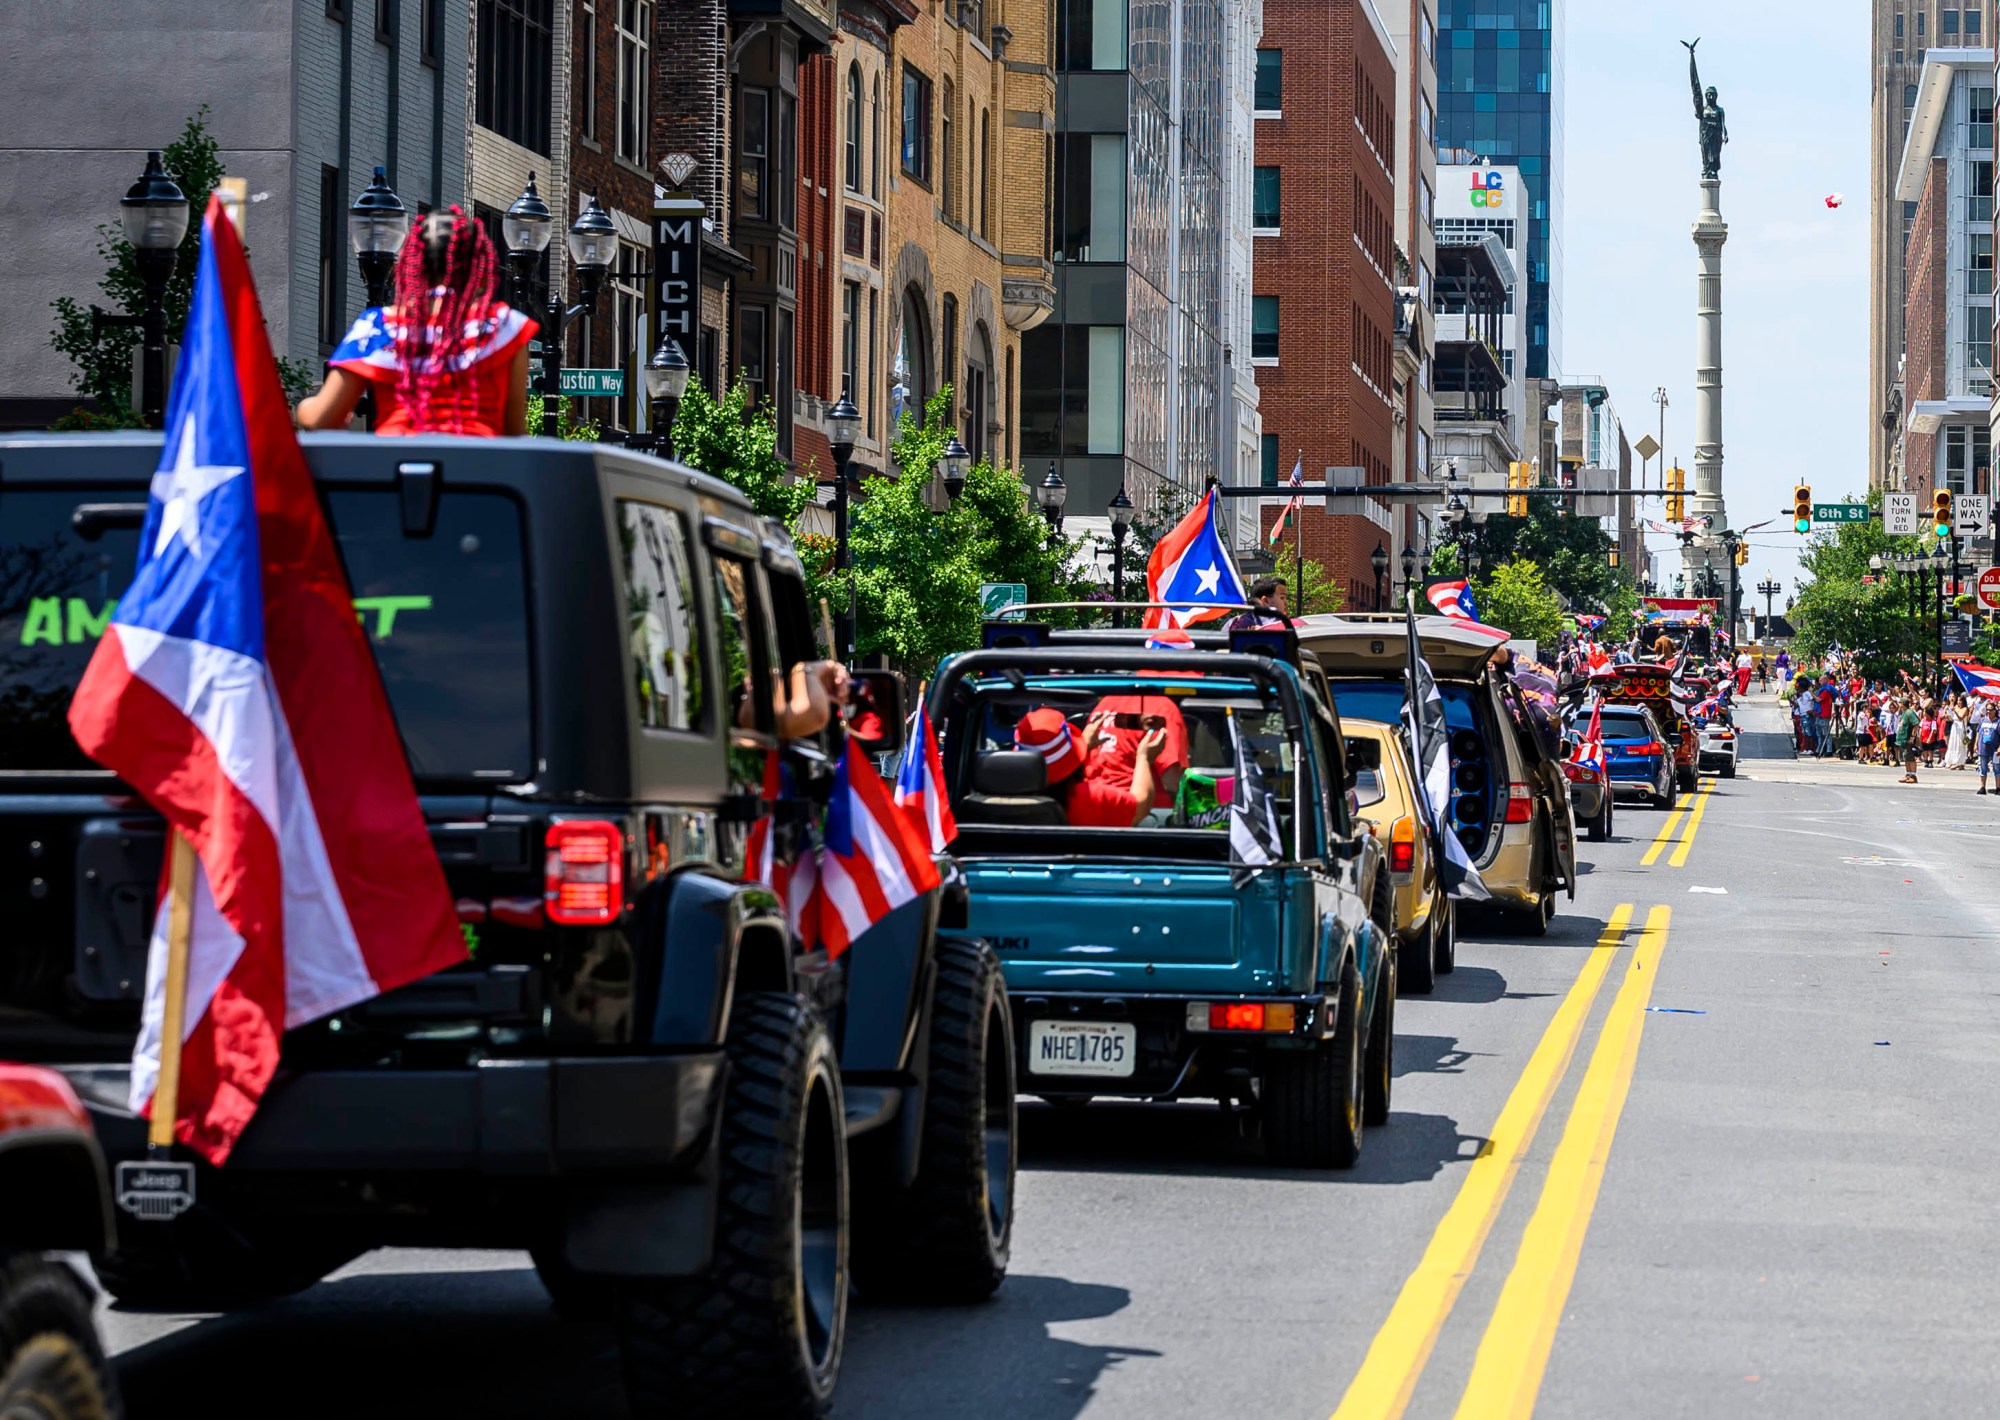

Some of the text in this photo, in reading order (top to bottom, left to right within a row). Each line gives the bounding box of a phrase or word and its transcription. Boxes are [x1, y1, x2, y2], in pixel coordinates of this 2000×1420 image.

[660, 220, 691, 363] MICH
[601, 375, 623, 393] Way
[1892, 497, 1910, 507] NO
[1960, 498, 1982, 508] ONE
[1818, 507, 1864, 519] 6th St
[1960, 510, 1983, 519] WAY
[1895, 516, 1907, 524] ON
[1893, 524, 1909, 532] RED
[1984, 575, 1995, 583] DO
